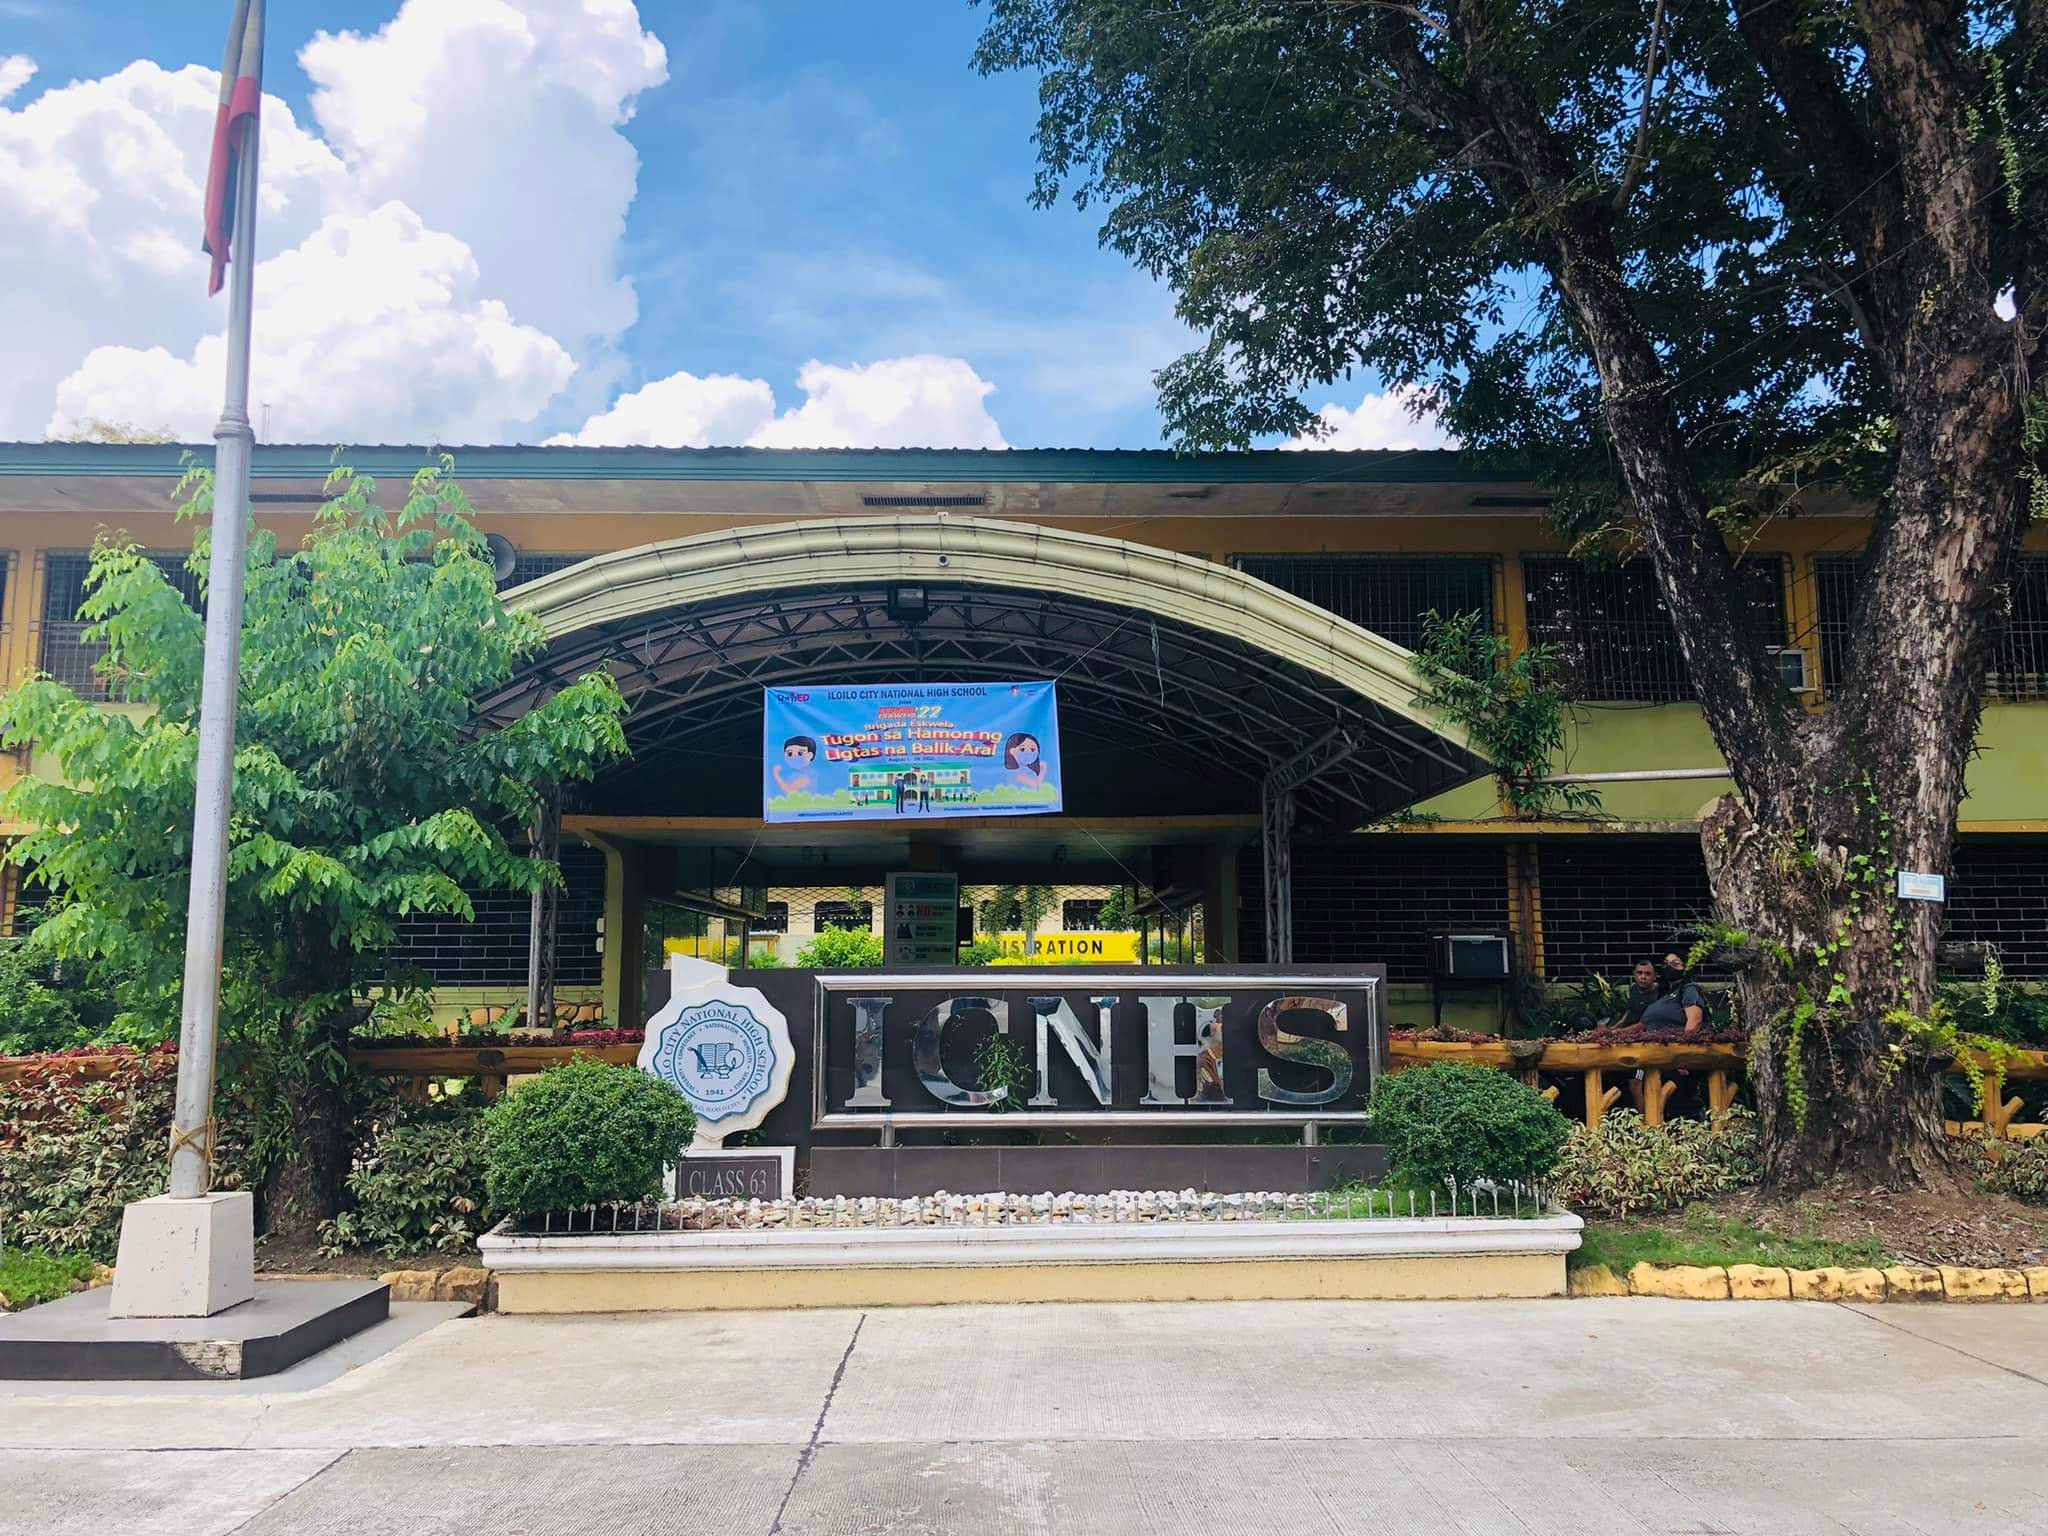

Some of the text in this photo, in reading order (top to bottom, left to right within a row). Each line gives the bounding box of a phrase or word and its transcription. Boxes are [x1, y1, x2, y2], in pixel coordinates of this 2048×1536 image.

[828, 687, 987, 700] ILOILO CITY NATIONAL HIGH SCHOOL
[822, 728, 1002, 747] Tugon sa Hamon ng
[825, 743, 998, 761] Ligtas na Balik-Aral
[680, 1008, 739, 1029] NATIONAL
[740, 1017, 764, 1045] HIGH
[664, 1029, 682, 1056] CITY
[846, 996, 1354, 1107] ICNHS
[745, 1046, 767, 1096] SCHOOL
[689, 1167, 767, 1196] CLASS 63
